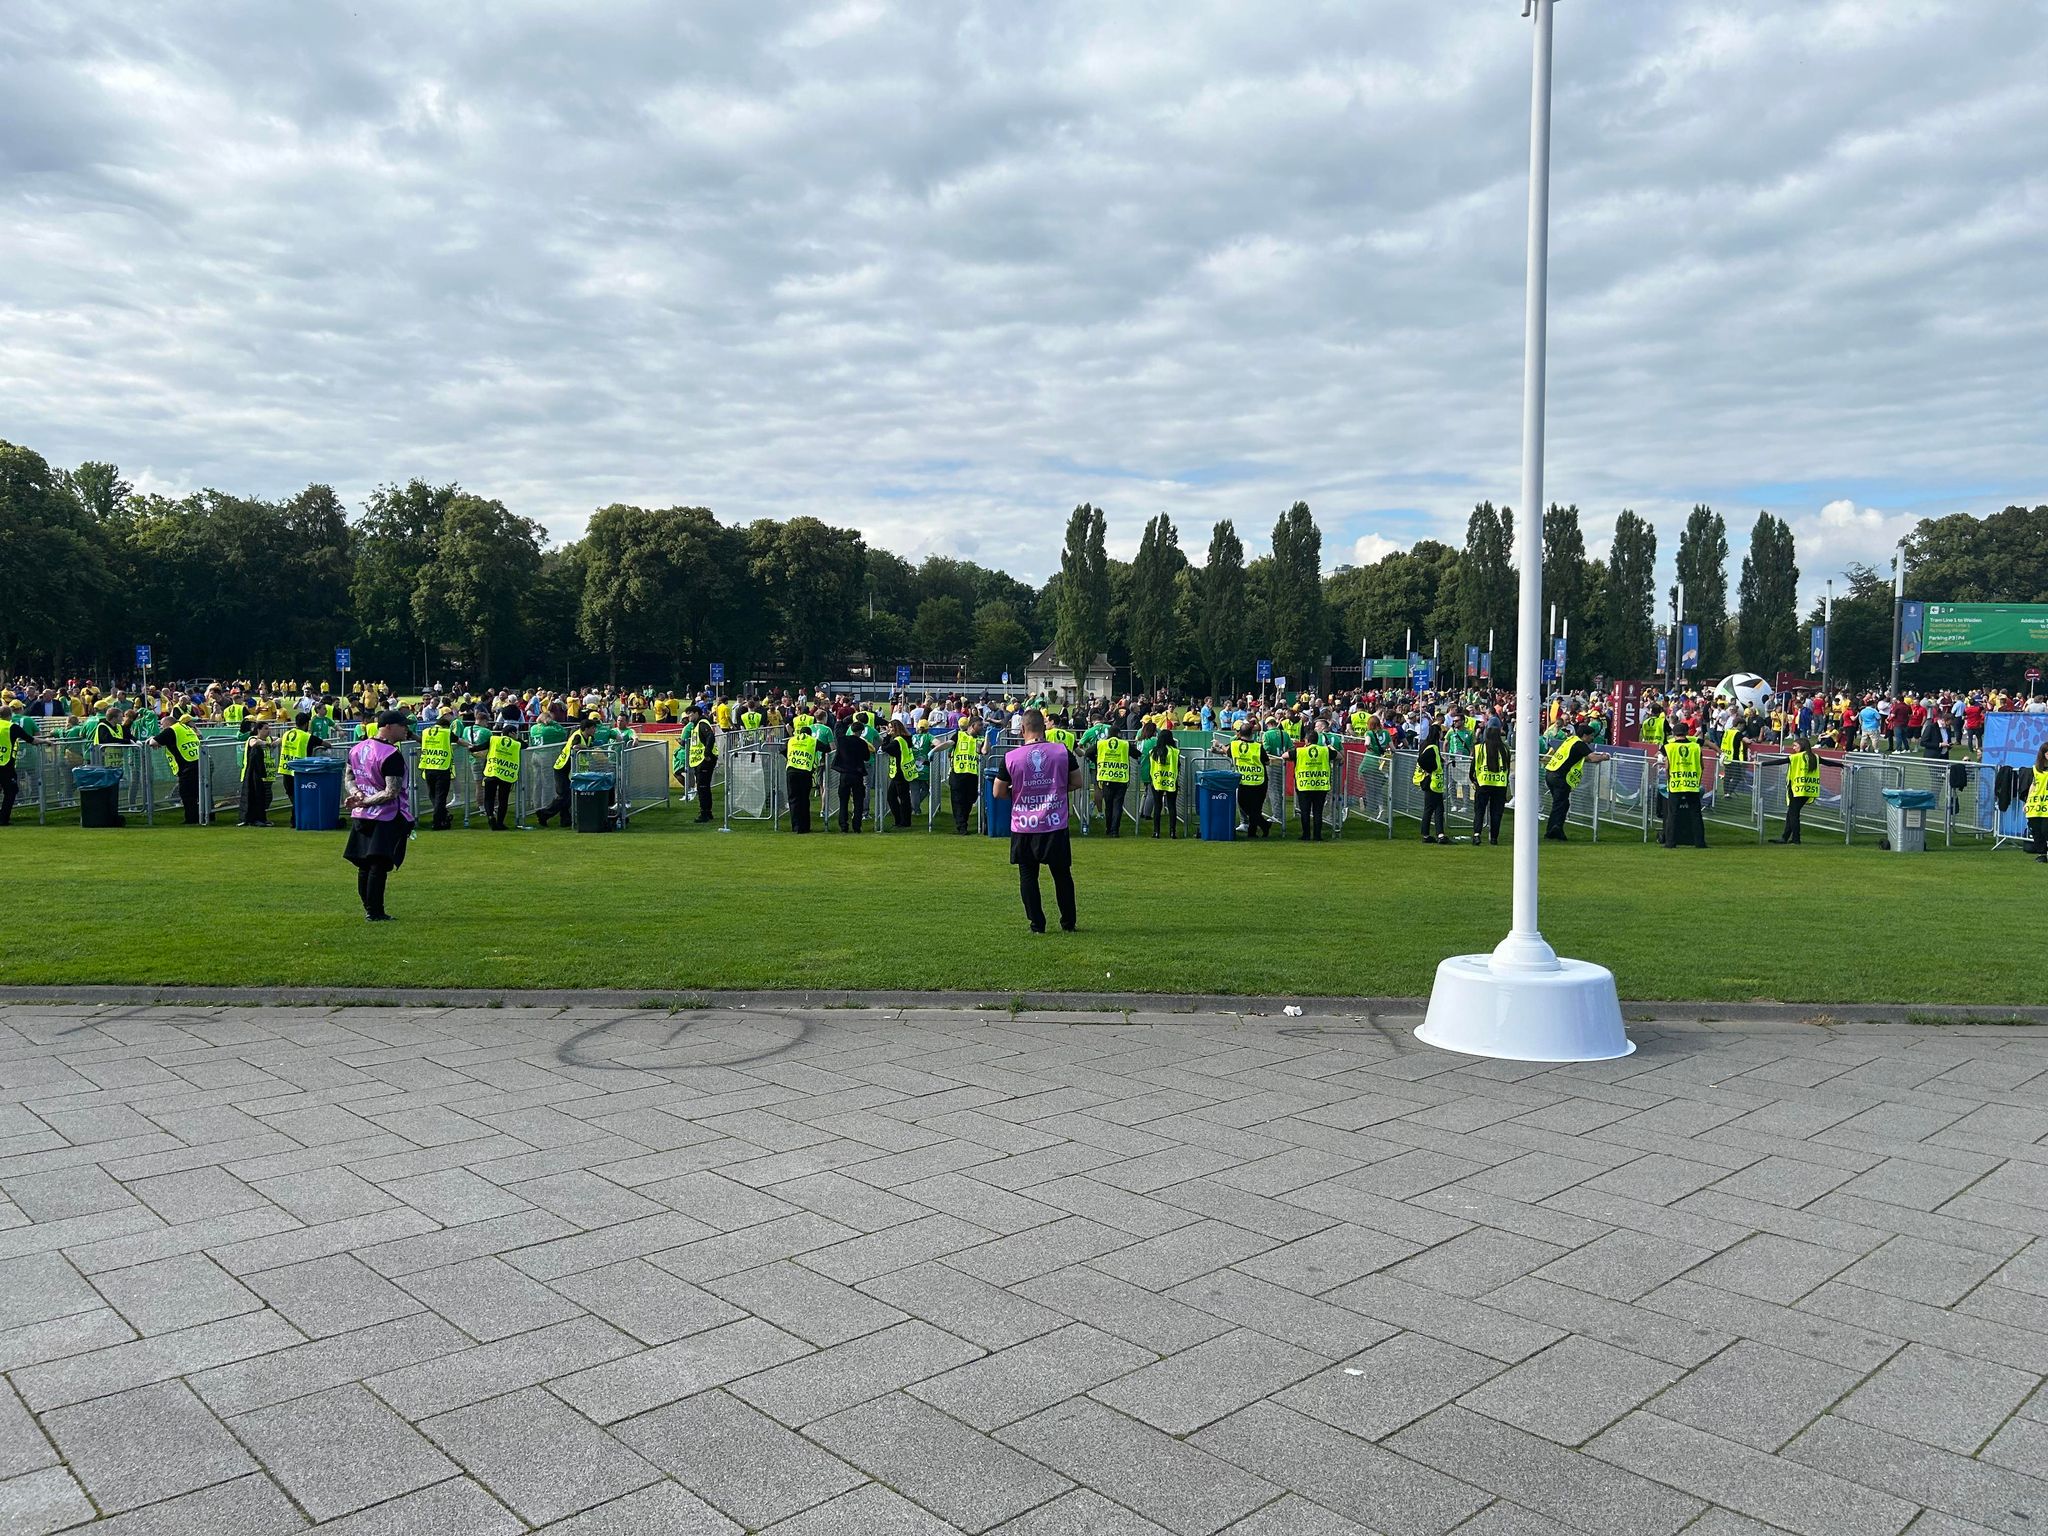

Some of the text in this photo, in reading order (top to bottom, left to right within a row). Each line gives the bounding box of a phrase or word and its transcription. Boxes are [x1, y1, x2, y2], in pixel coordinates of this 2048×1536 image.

[1625, 702, 1635, 728] VIP
[421, 749, 449, 758] EWARD
[1098, 762, 1129, 770] SEWARD
[1099, 770, 1127, 779] 7-0651
[1670, 771, 1698, 779] TEWAR
[1021, 793, 1058, 804] VISITING
[1029, 800, 1064, 812] SUPPORT
